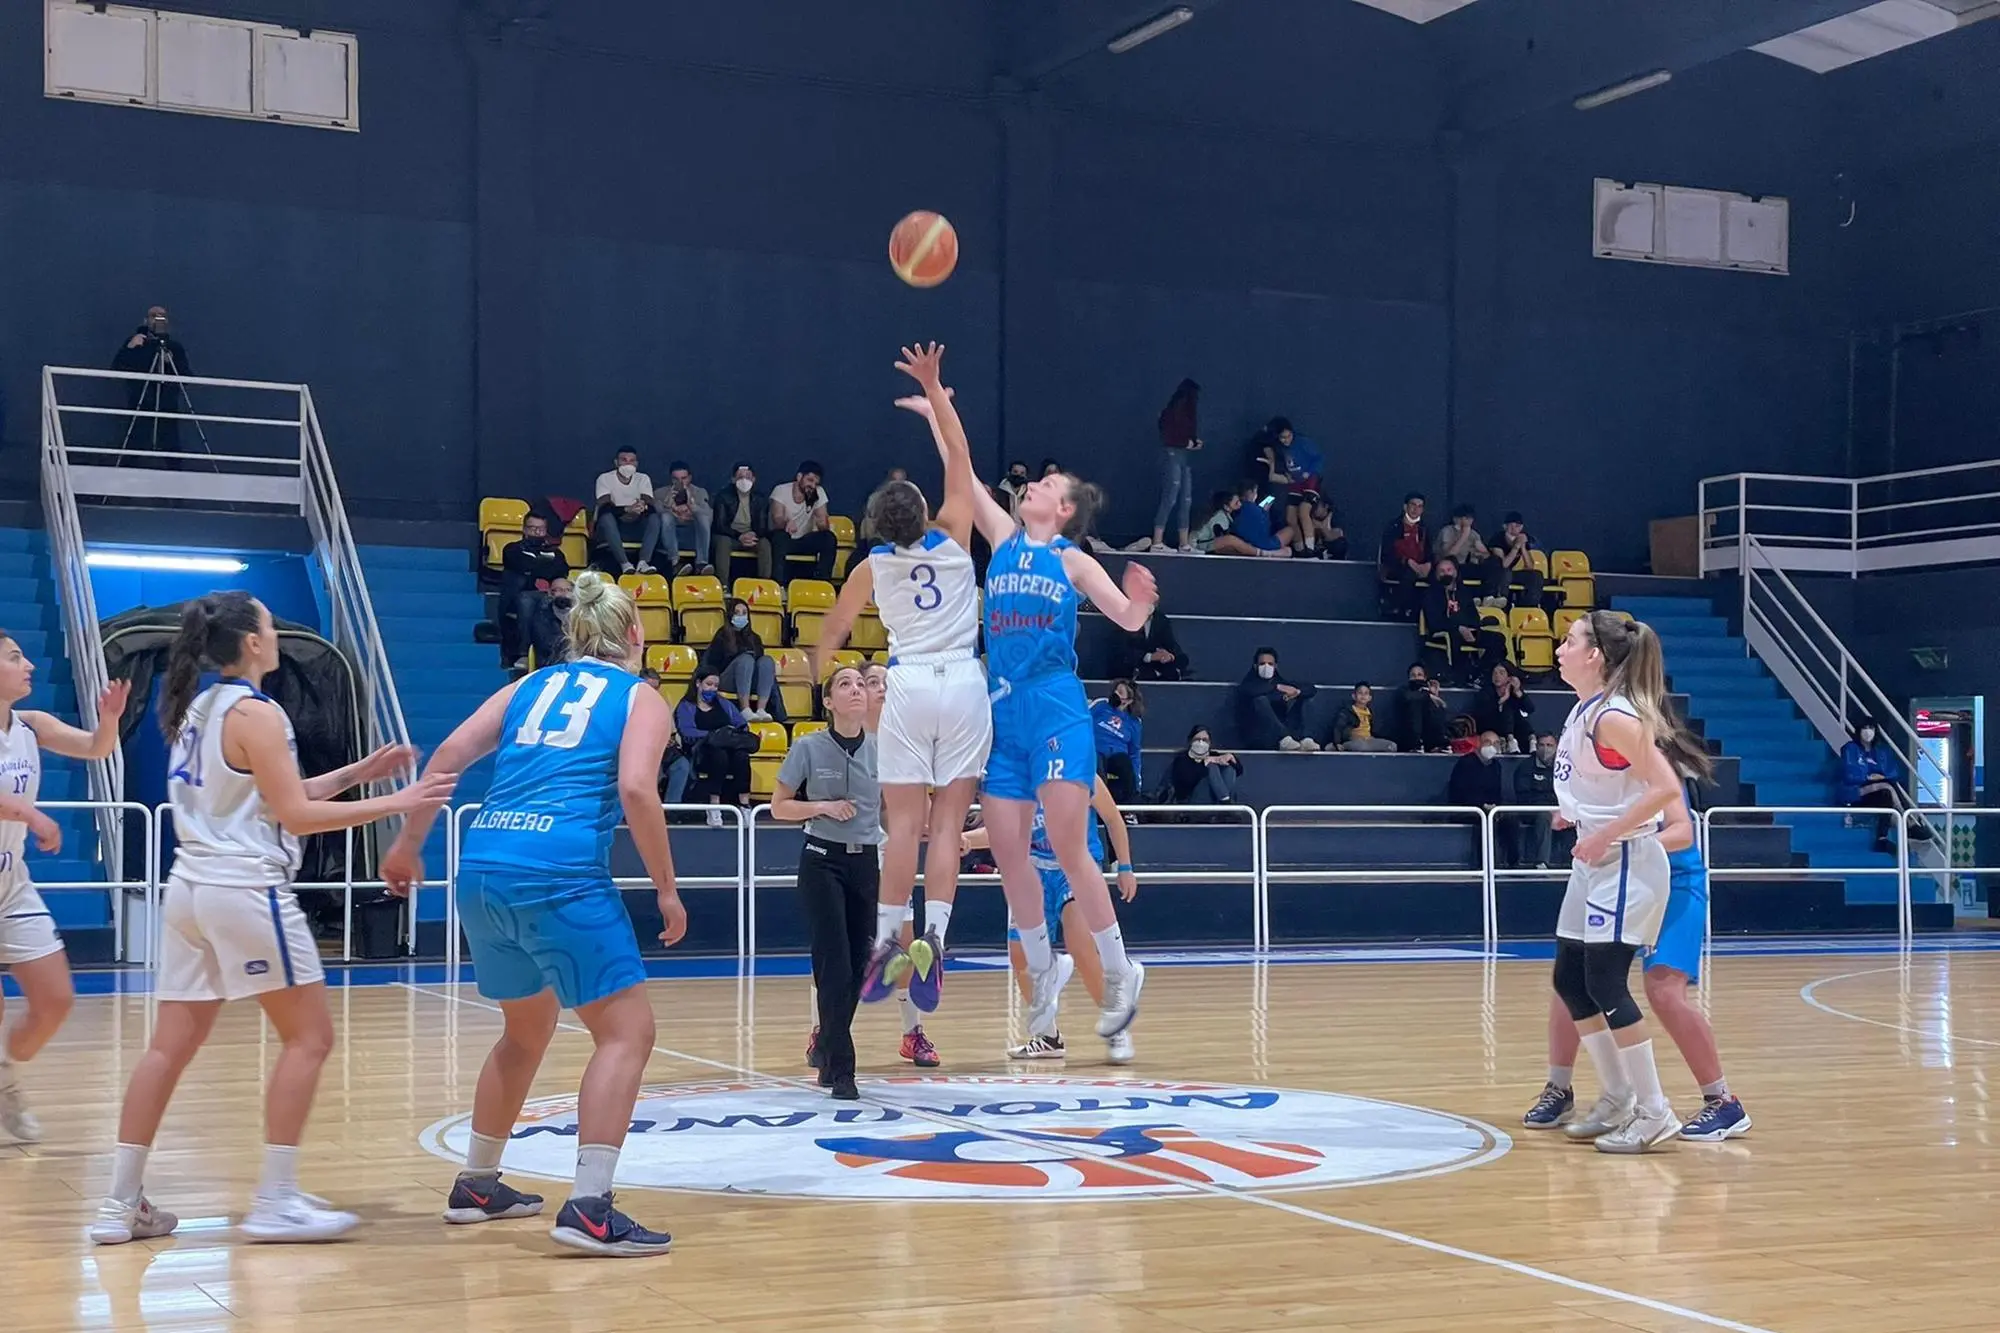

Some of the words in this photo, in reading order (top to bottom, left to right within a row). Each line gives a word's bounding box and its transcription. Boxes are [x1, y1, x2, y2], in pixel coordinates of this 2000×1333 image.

[1018, 551, 1033, 570] 12
[910, 563, 942, 611] 3
[988, 572, 1067, 604] MERCEDE
[515, 671, 608, 749] 13
[168, 725, 204, 787] 21
[1047, 758, 1065, 780] 12
[12, 774, 29, 794] 17
[470, 810, 554, 833] ALGHERO
